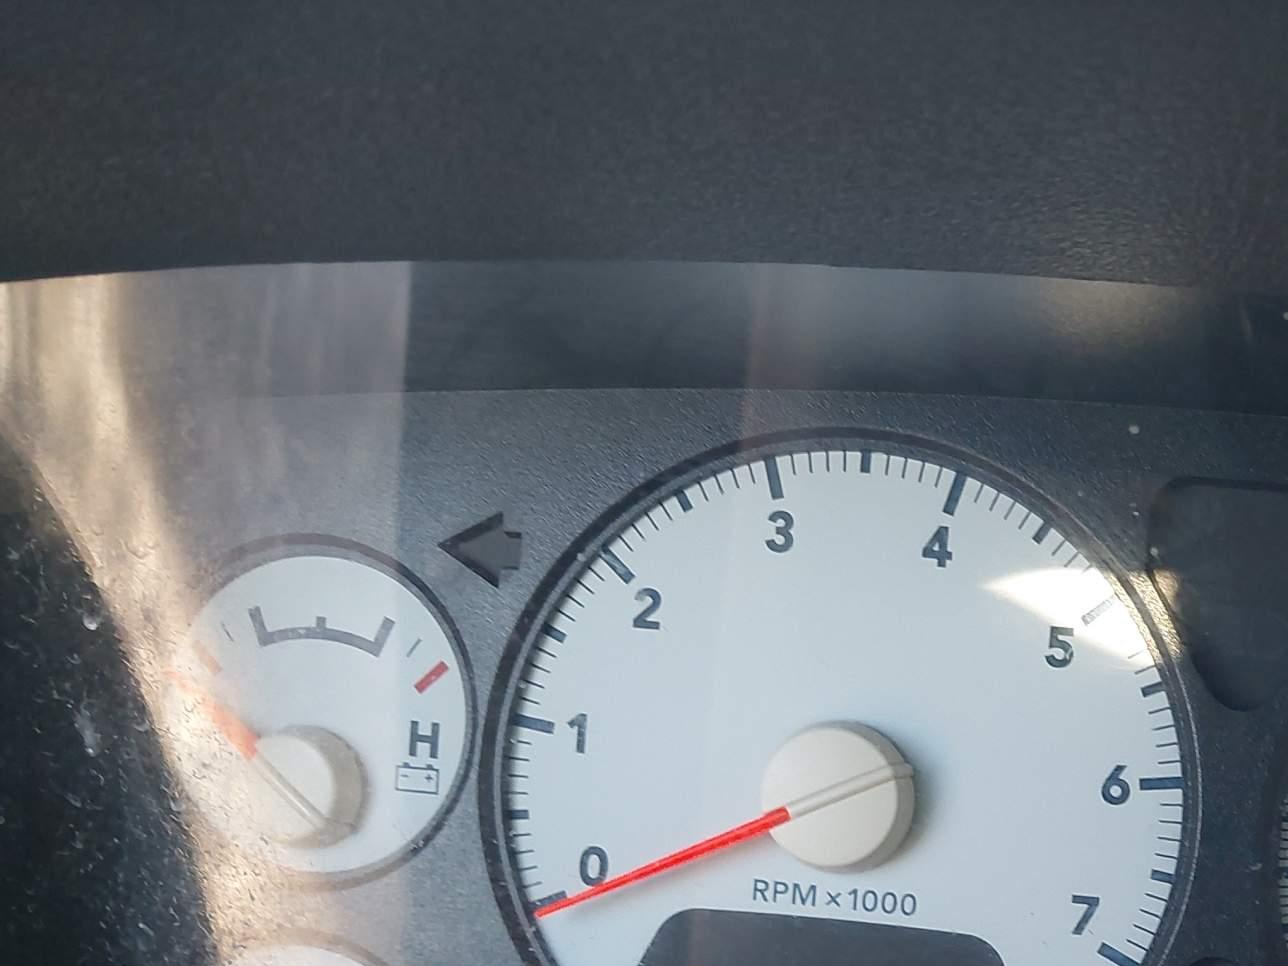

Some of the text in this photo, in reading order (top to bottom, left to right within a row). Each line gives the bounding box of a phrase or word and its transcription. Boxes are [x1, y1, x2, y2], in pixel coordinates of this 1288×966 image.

[766, 511, 795, 553] 3
[922, 526, 953, 567] 4
[632, 588, 661, 629] 2
[1045, 627, 1074, 667] 5
[409, 720, 440, 759] H
[568, 714, 588, 753] 1
[1101, 765, 1131, 805] 6
[580, 847, 609, 886] 0
[753, 878, 818, 907] RPM
[1071, 896, 1099, 934] 7
